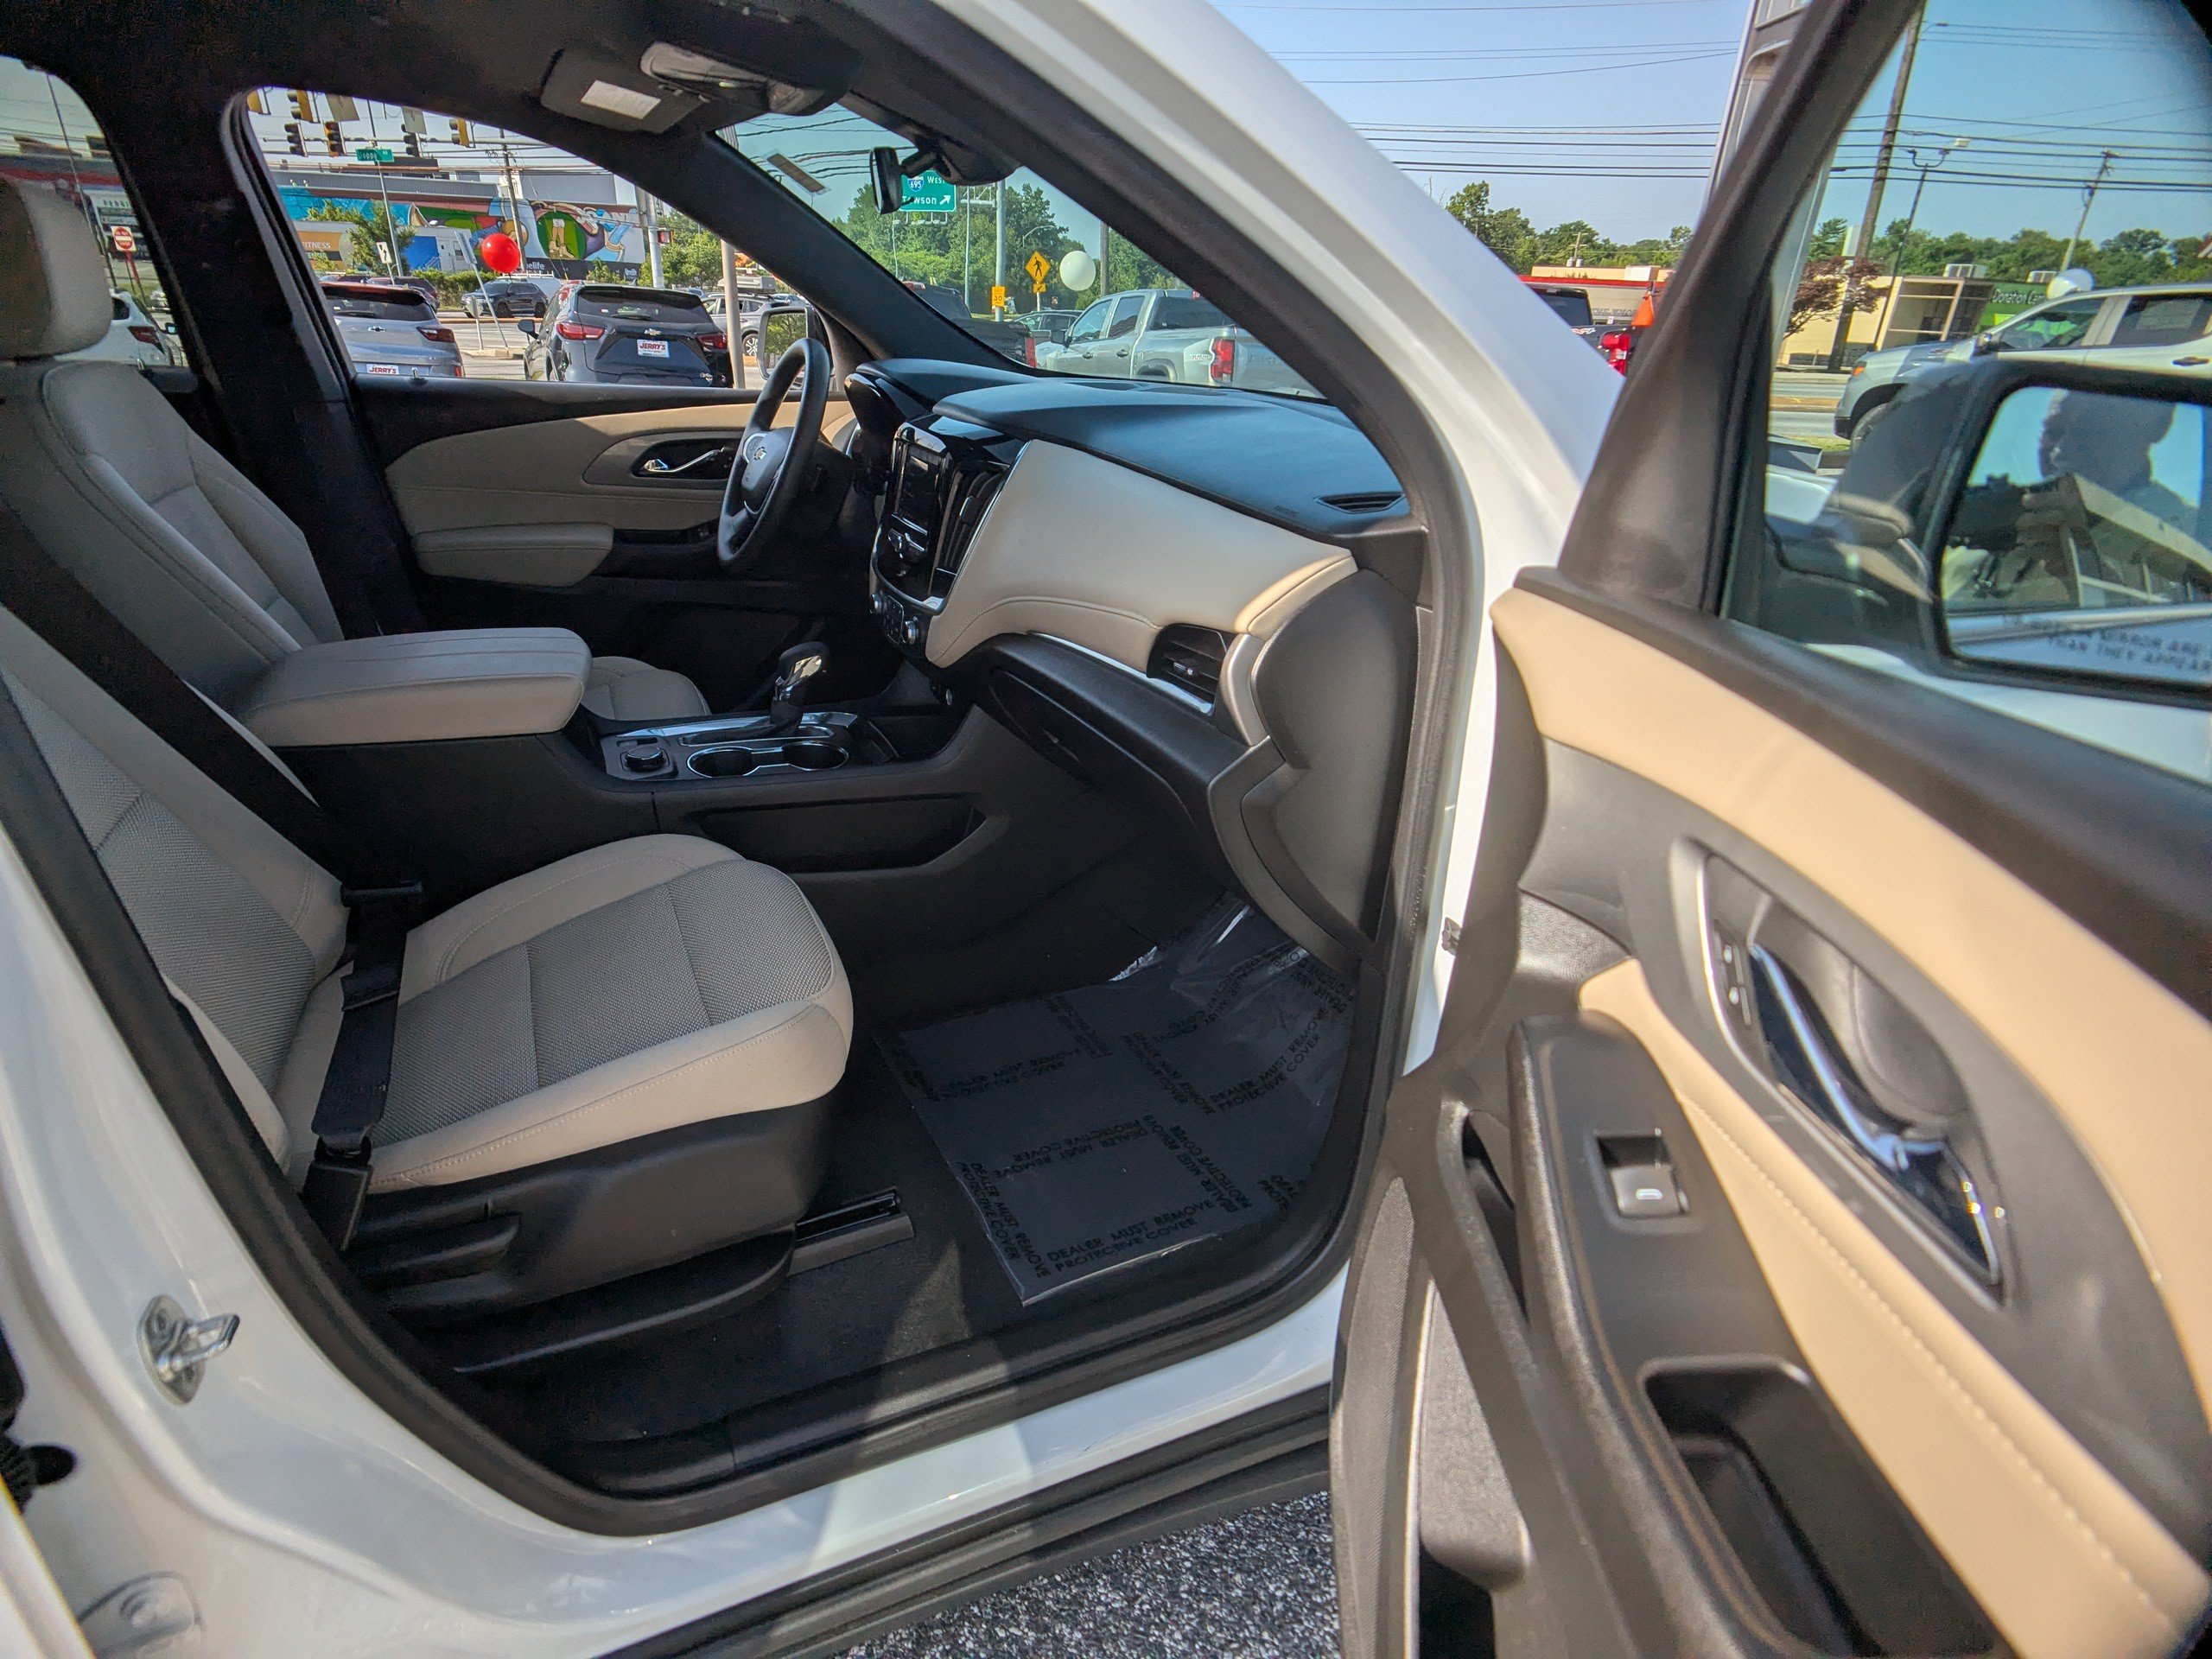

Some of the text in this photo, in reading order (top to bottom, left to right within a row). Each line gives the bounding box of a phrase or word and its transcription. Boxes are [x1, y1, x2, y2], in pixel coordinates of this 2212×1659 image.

[902, 195, 938, 205] Twson
[910, 180, 922, 188] 695
[1259, 1054, 1288, 1082] MUST
[1287, 1007, 1329, 1054] REMOVE
[1286, 1033, 1322, 1073] COVER
[989, 1219, 1020, 1261] COVER
[1046, 1198, 1215, 1263] DEALER MUST REMOVE
[1054, 1217, 1198, 1272] PROTECTIVE COVER
[1014, 1231, 1052, 1279] REMOVE
